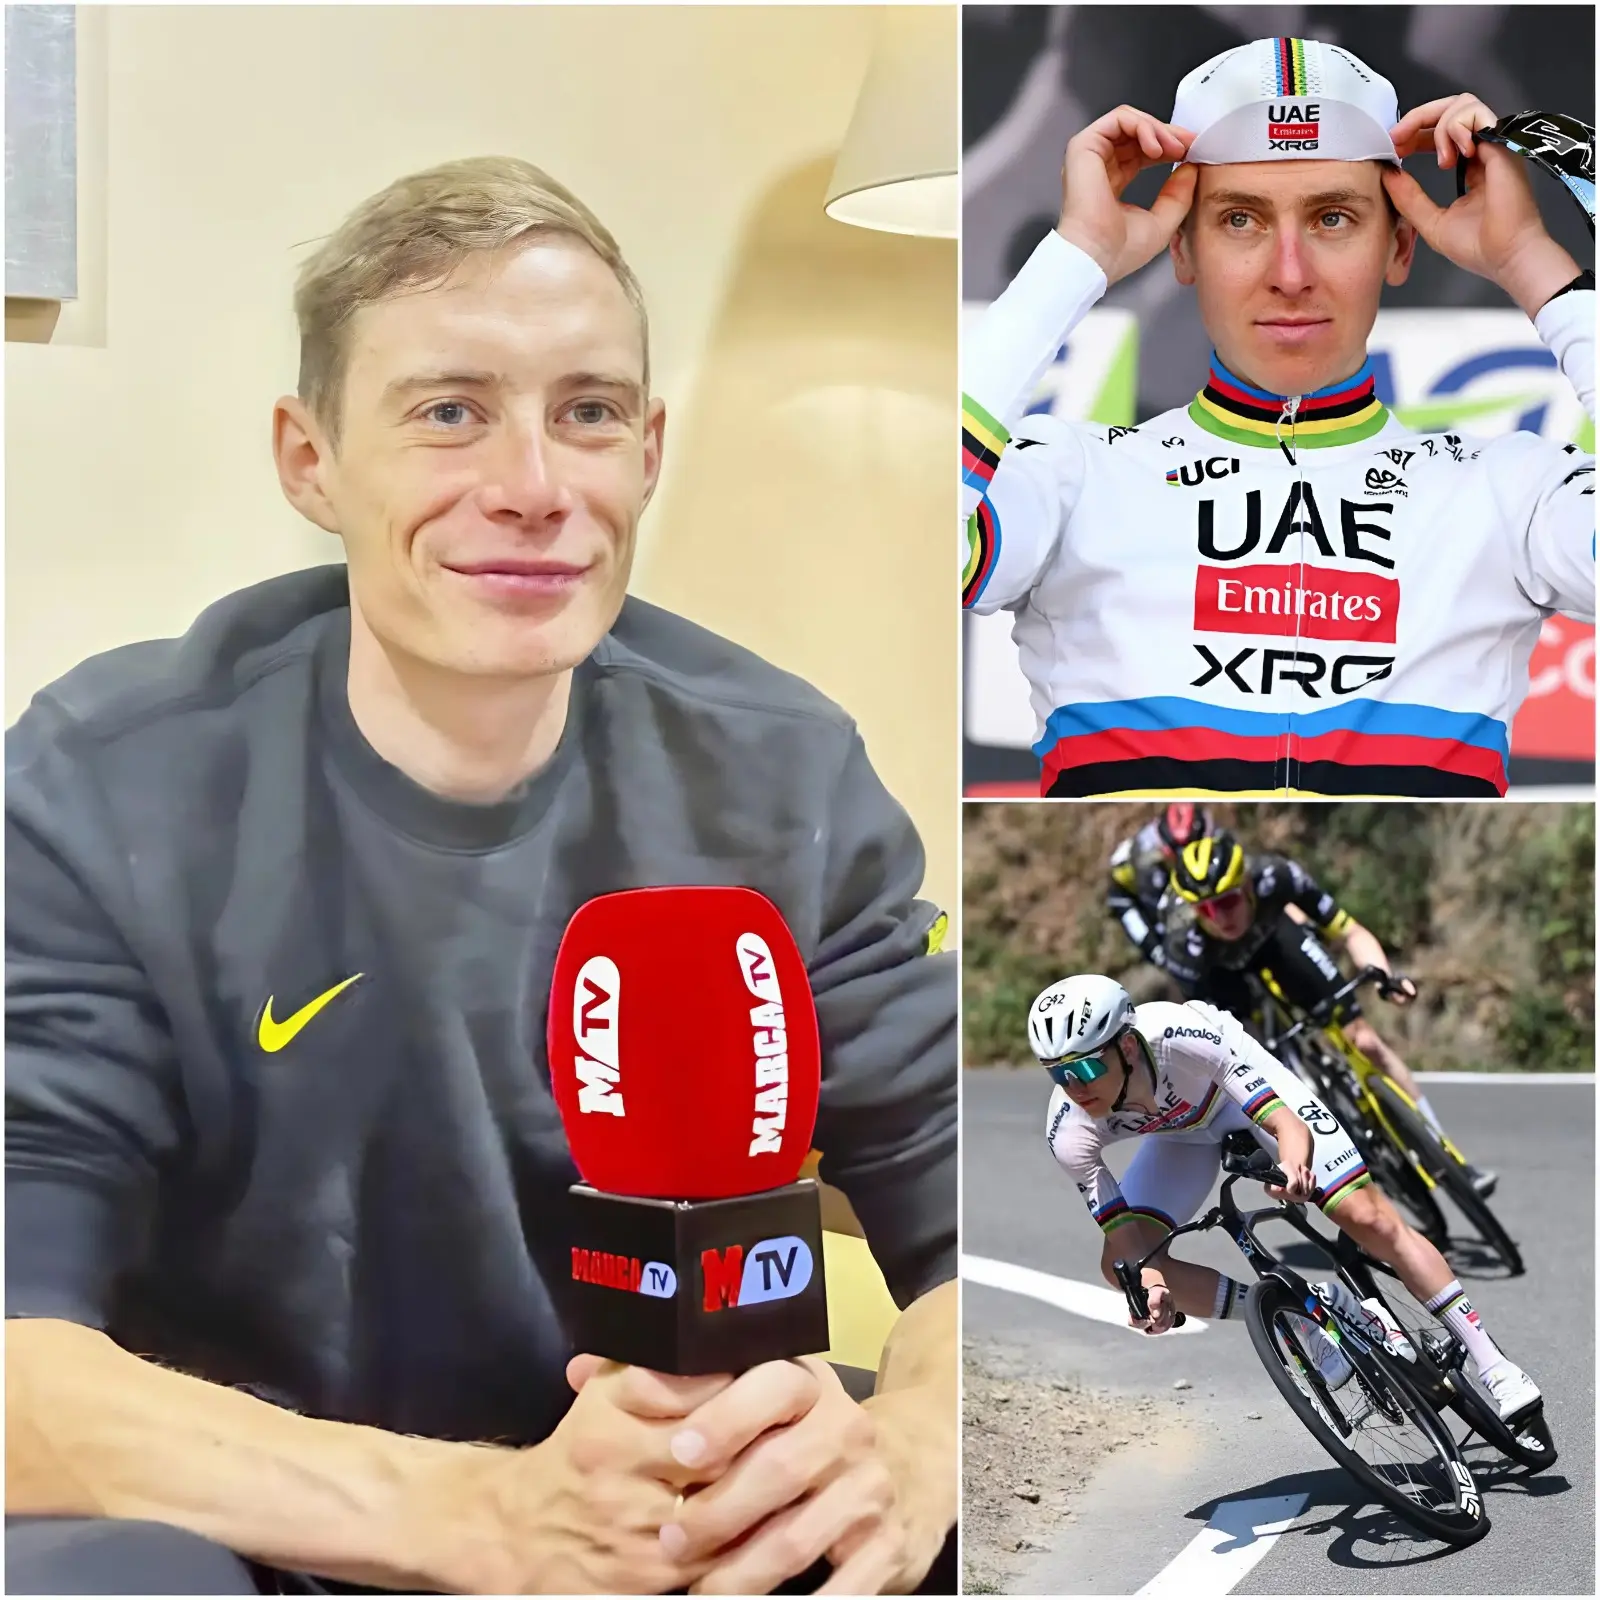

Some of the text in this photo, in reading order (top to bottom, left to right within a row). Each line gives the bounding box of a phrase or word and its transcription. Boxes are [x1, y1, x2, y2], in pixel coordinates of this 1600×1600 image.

[1268, 104, 1320, 123] UAE
[1268, 139, 1319, 151] XRG
[1179, 456, 1241, 487] UCI
[1197, 480, 1396, 570] UAE
[1217, 578, 1382, 622] Emirates
[1189, 643, 1396, 699] XRG
[1174, 1026, 1222, 1045] Analog
[748, 1000, 789, 1157] MARCA
